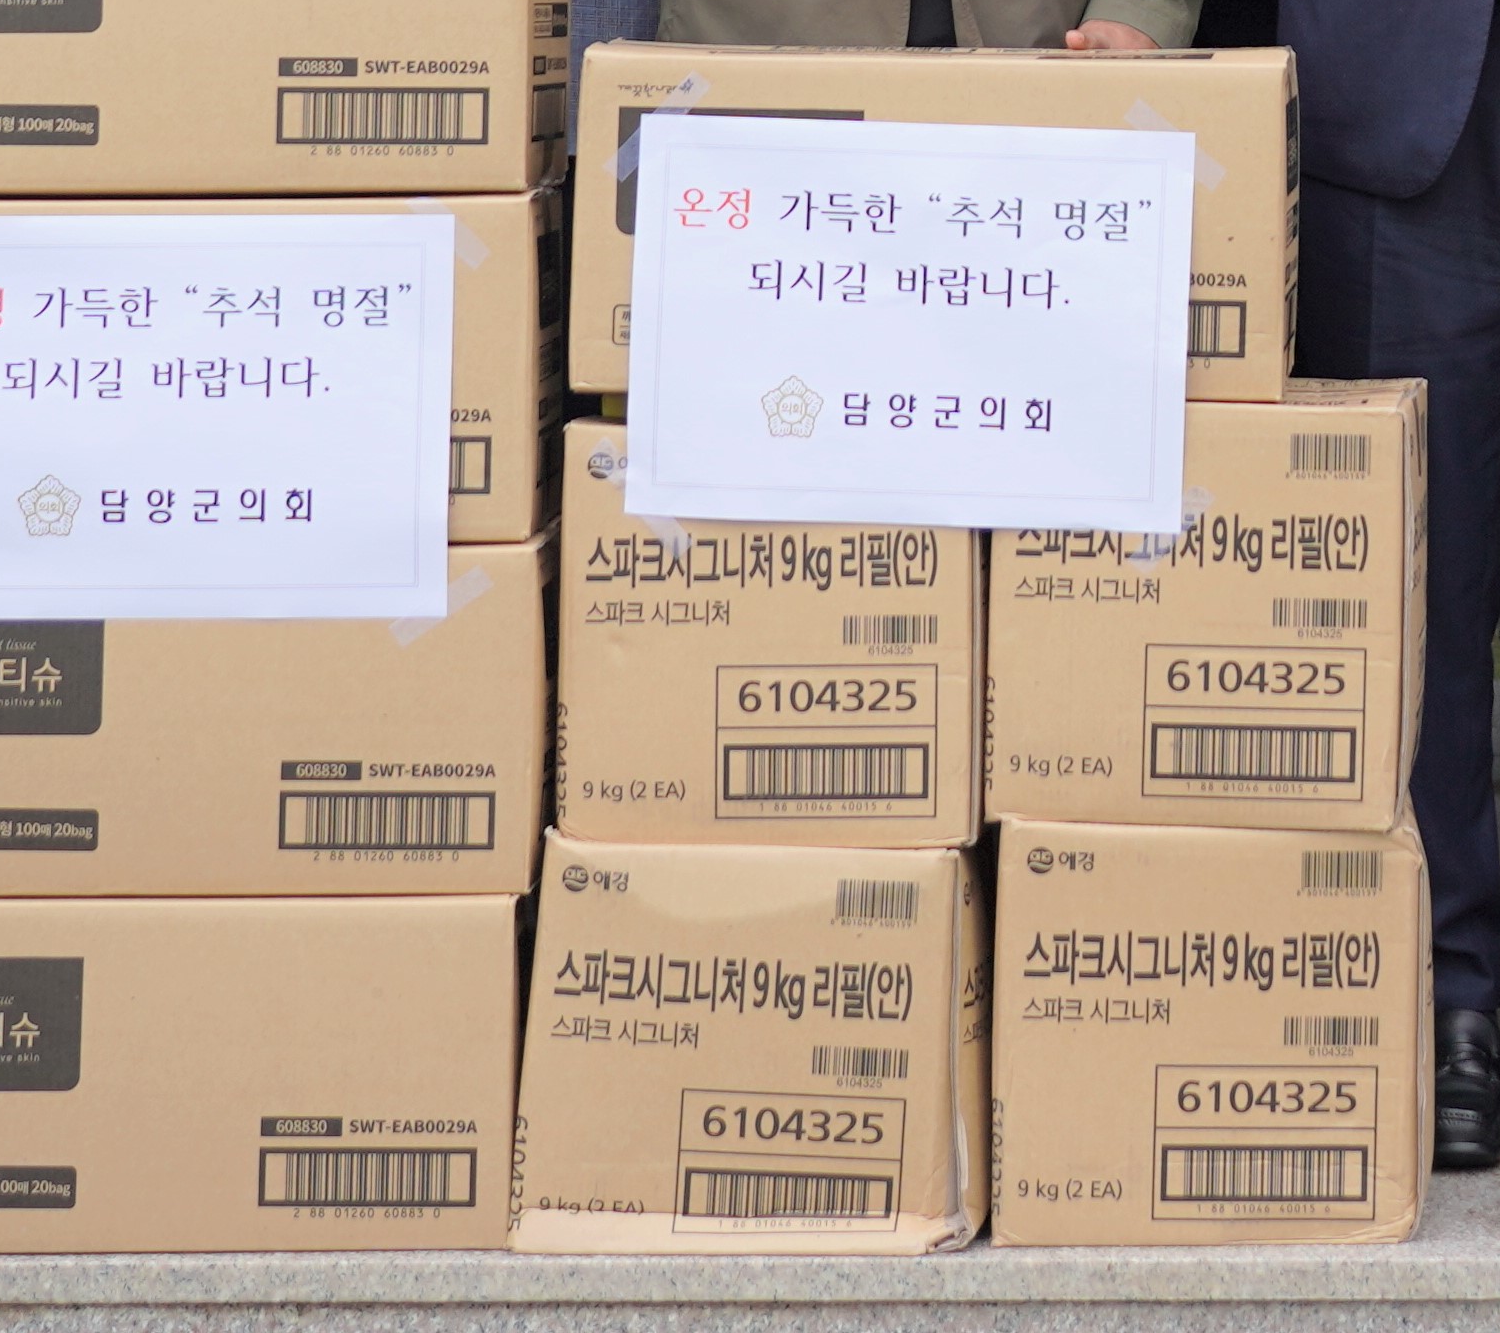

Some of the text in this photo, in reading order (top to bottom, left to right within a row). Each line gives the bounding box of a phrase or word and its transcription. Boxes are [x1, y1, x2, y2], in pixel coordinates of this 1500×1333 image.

[293, 61, 489, 74] 608830 SWT-EAB0029A
[673, 188, 752, 230] 온정
[780, 190, 903, 235] 가득한
[748, 259, 1071, 310] 되시길 바랍니다.
[32, 286, 158, 329] 가득한
[2, 356, 331, 401] 되시길 바랍니다.
[1271, 514, 1368, 571] 리필(안)
[585, 532, 773, 589] 스파크시그니처
[840, 529, 938, 588] 리필(안)
[1014, 575, 1161, 604] 스파크 시그니처
[585, 599, 730, 626] 스파크 시그니처
[868, 646, 913, 655] 6104325
[1167, 660, 1346, 694] 6104325
[738, 679, 917, 713] 6104325
[296, 762, 496, 779] 608830 SWT-EAB0029A
[1058, 851, 1095, 872] 애경
[593, 869, 629, 893] 애경
[1023, 929, 1215, 987] 스파크시그니처
[1282, 931, 1379, 989] 리필(안)
[553, 949, 747, 1013] 스파크시그니처
[813, 961, 913, 1021] 리필(안)
[1022, 996, 1170, 1025] 스파크 시그니처
[550, 1014, 700, 1049] 스파크 시그니처
[18, 1053, 40, 1062] skin
[1308, 1047, 1354, 1057] 6104325
[836, 1077, 882, 1089] 6104325
[1177, 1080, 1357, 1114] 6104325
[275, 1119, 478, 1134] 608830 SWT-EAB0029A
[703, 1105, 884, 1144] 6104325
[1017, 1180, 1028, 1197] 9
[1035, 1178, 1059, 1200] kg
[1090, 1179, 1123, 1200] EA)
